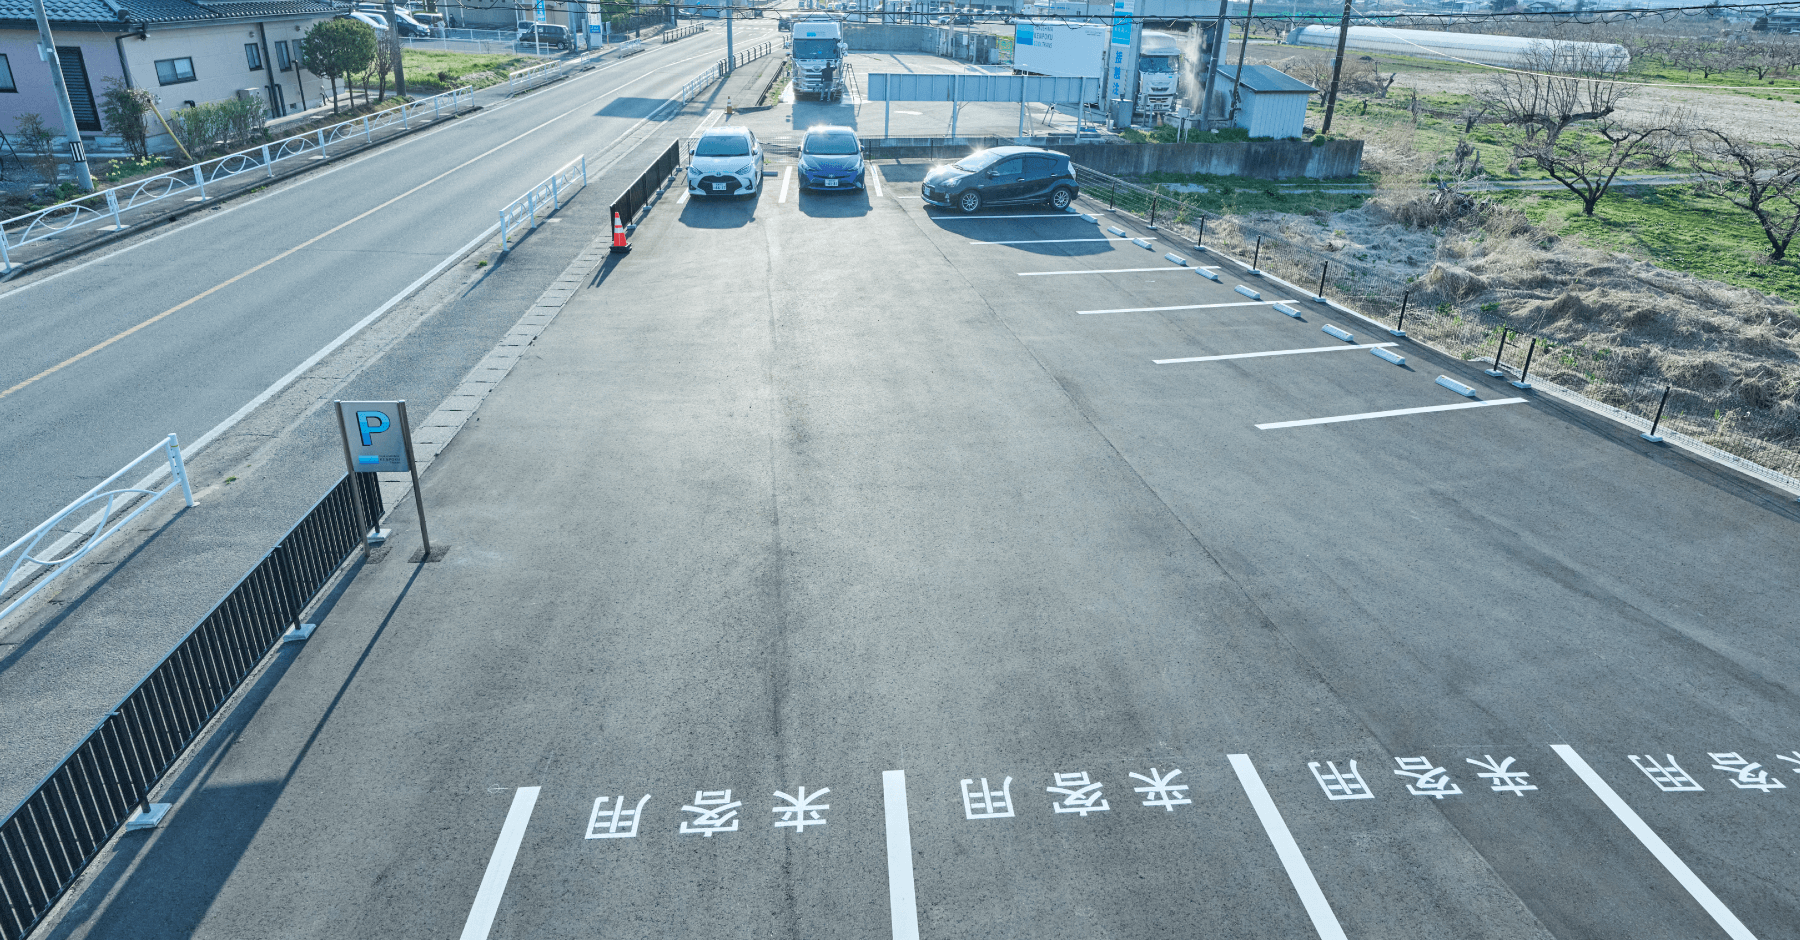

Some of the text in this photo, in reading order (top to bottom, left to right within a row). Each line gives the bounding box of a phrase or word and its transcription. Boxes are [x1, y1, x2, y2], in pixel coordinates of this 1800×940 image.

[356, 411, 390, 446] P
[961, 768, 1191, 819] 来客用
[1308, 755, 1536, 800] 来客用
[585, 786, 829, 839] 来客用
